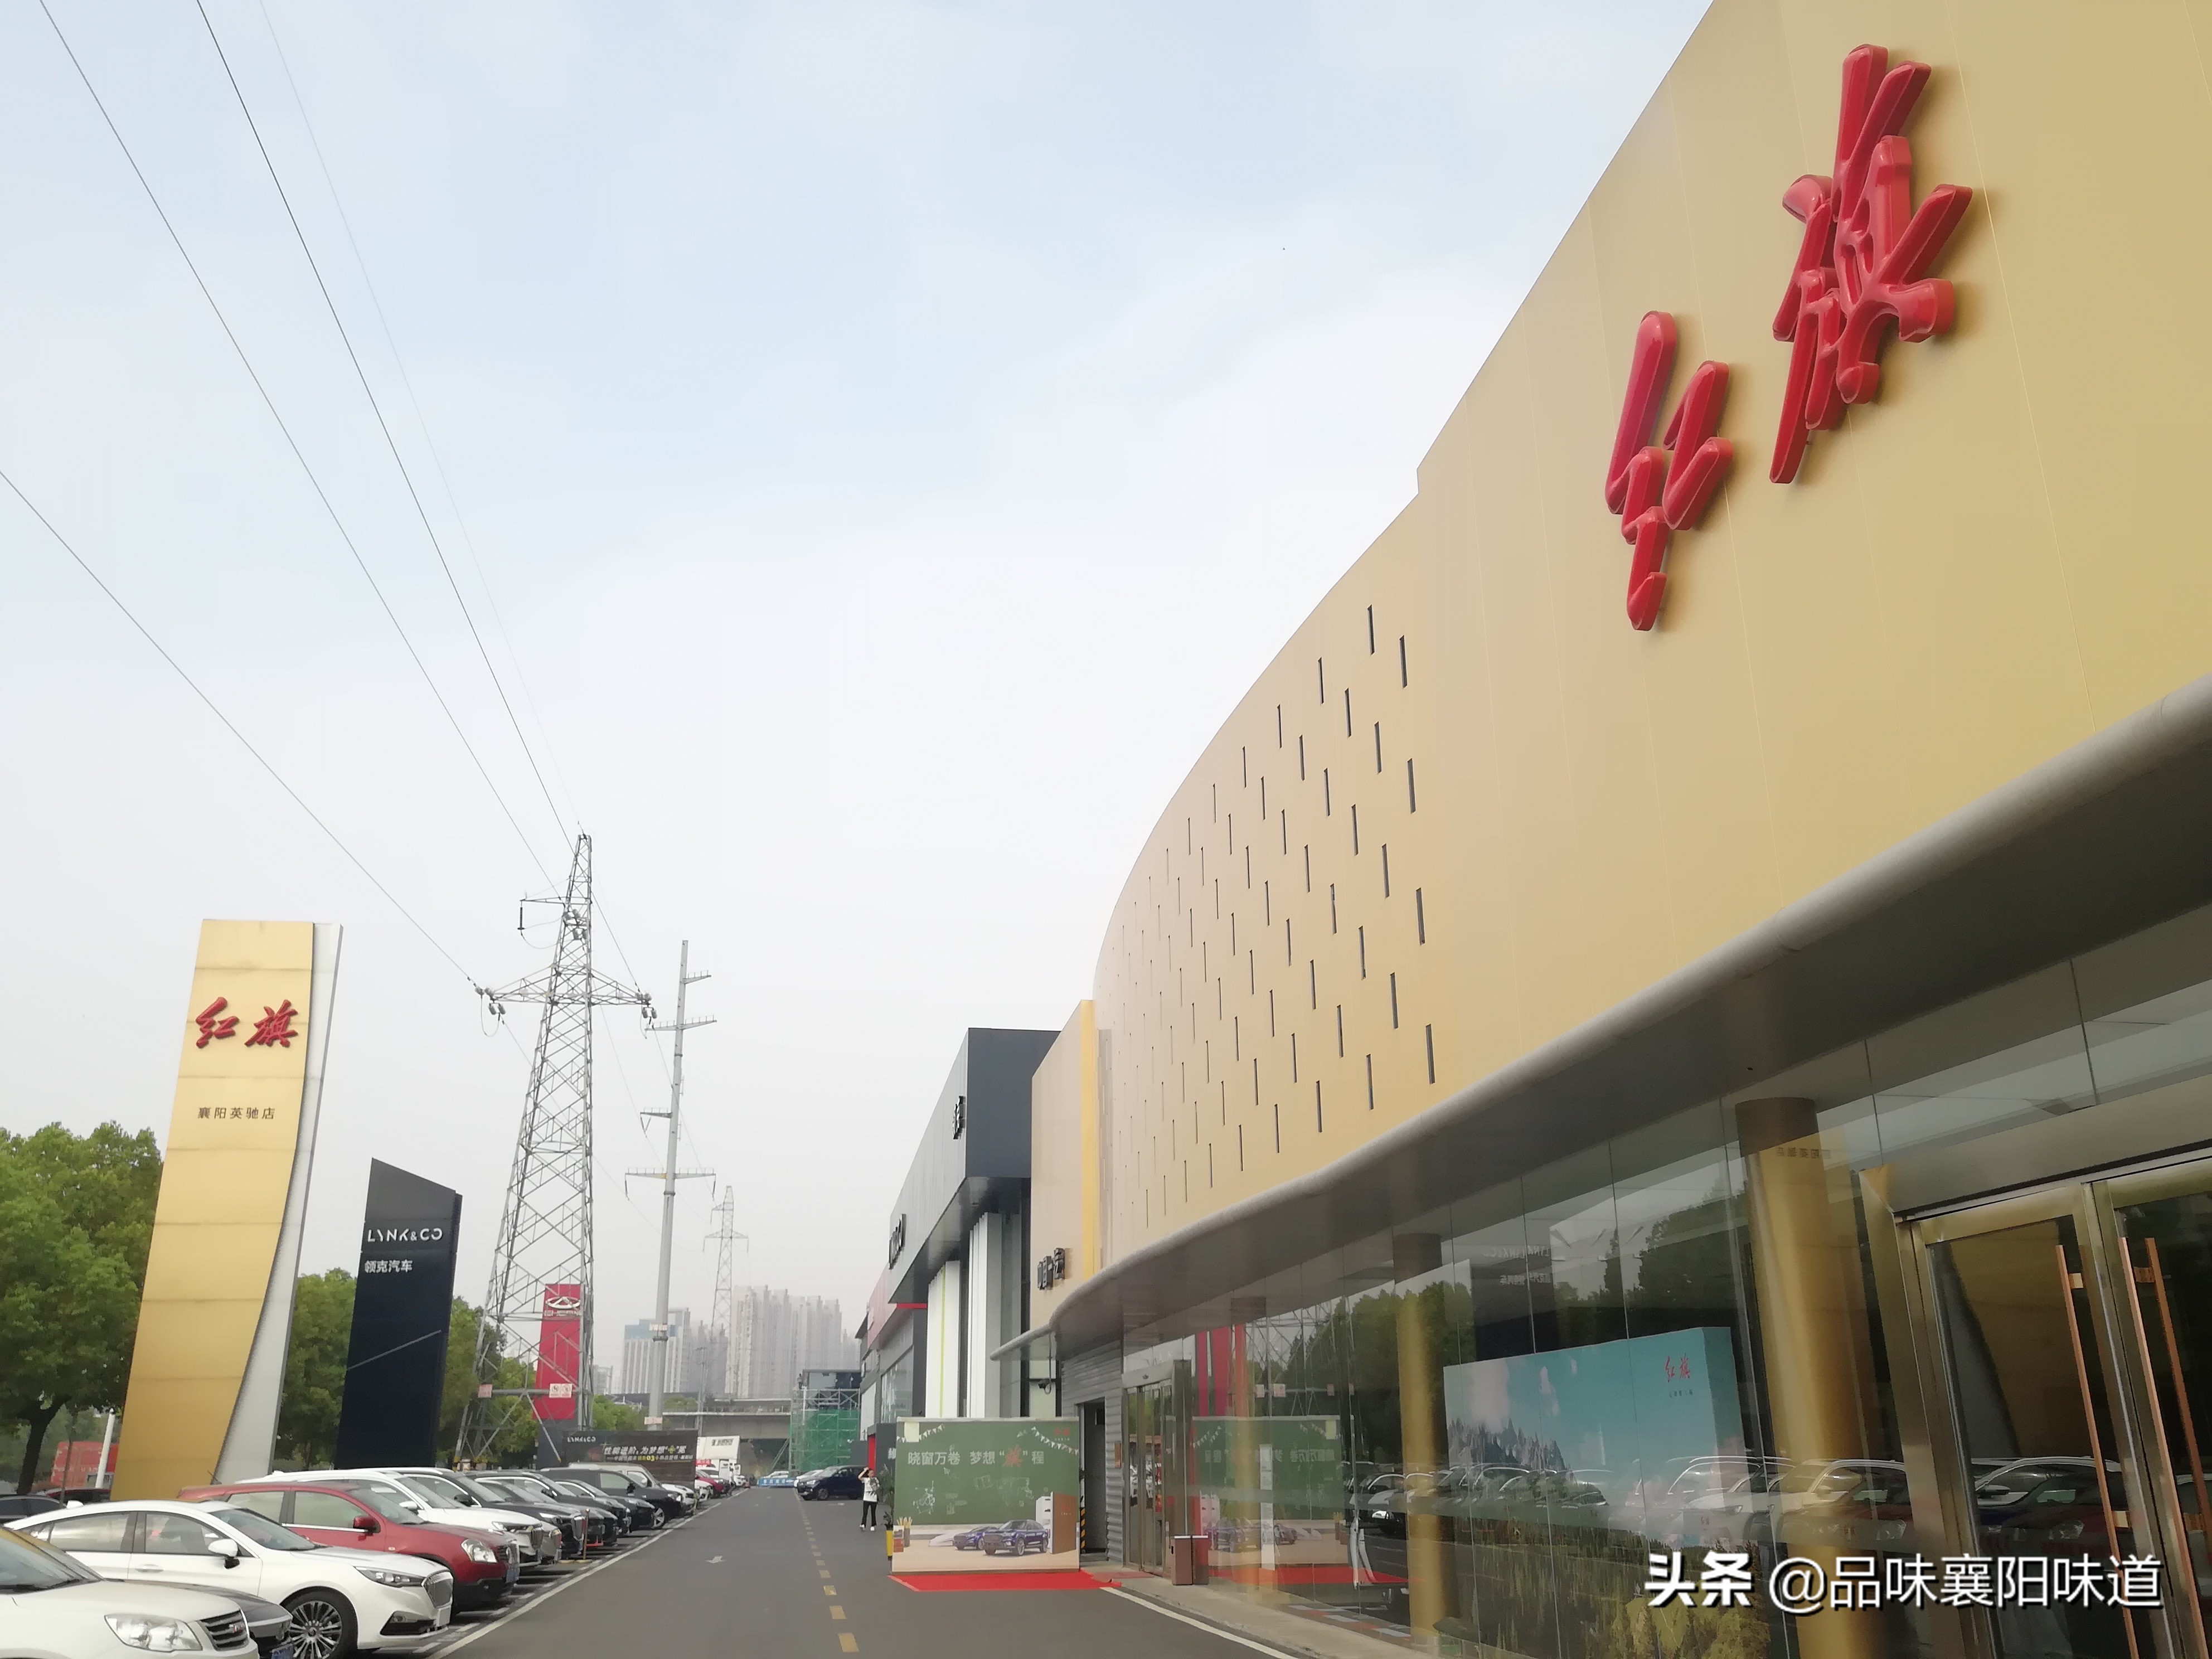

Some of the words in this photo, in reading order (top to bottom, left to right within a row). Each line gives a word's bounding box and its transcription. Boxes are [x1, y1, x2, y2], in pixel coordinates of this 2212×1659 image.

[1604, 43, 1973, 631] 红旗
[195, 996, 299, 1049] 红旗
[197, 1107, 275, 1119] 襄阳英驰店
[367, 1228, 443, 1243] LYNK&CO
[364, 1259, 413, 1273] 领克汽车
[908, 1451, 961, 1466] 晓窗万卷
